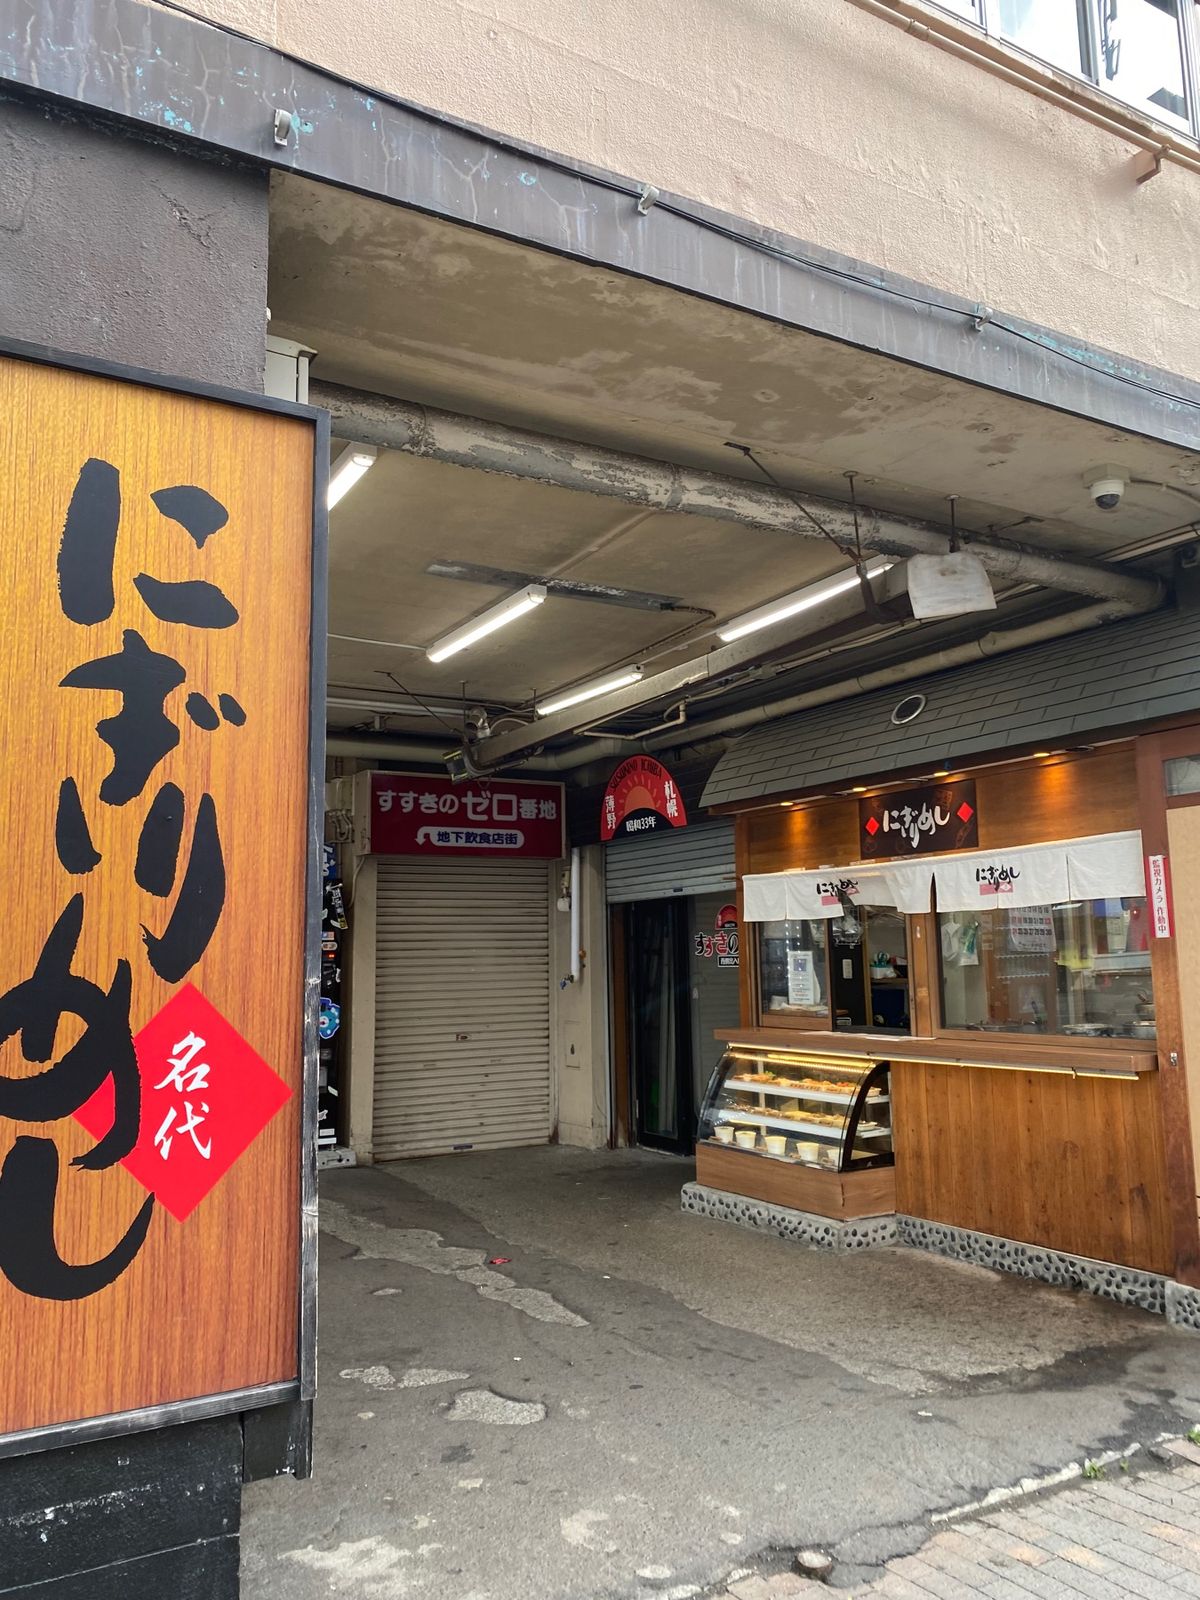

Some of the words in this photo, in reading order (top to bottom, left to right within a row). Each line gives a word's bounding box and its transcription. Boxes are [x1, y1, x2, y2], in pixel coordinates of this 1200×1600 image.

[376, 789, 557, 821] すすきのゼロ番地
[664, 780, 678, 818] 札幌
[437, 831, 518, 845] 地下飲食店街
[626, 816, 657, 832] 昭和33年
[883, 802, 950, 848] にぎりめし
[0, 457, 246, 1300] にぎりめし
[976, 864, 1020, 892] にぎりめし
[154, 1030, 213, 1164] 名代
